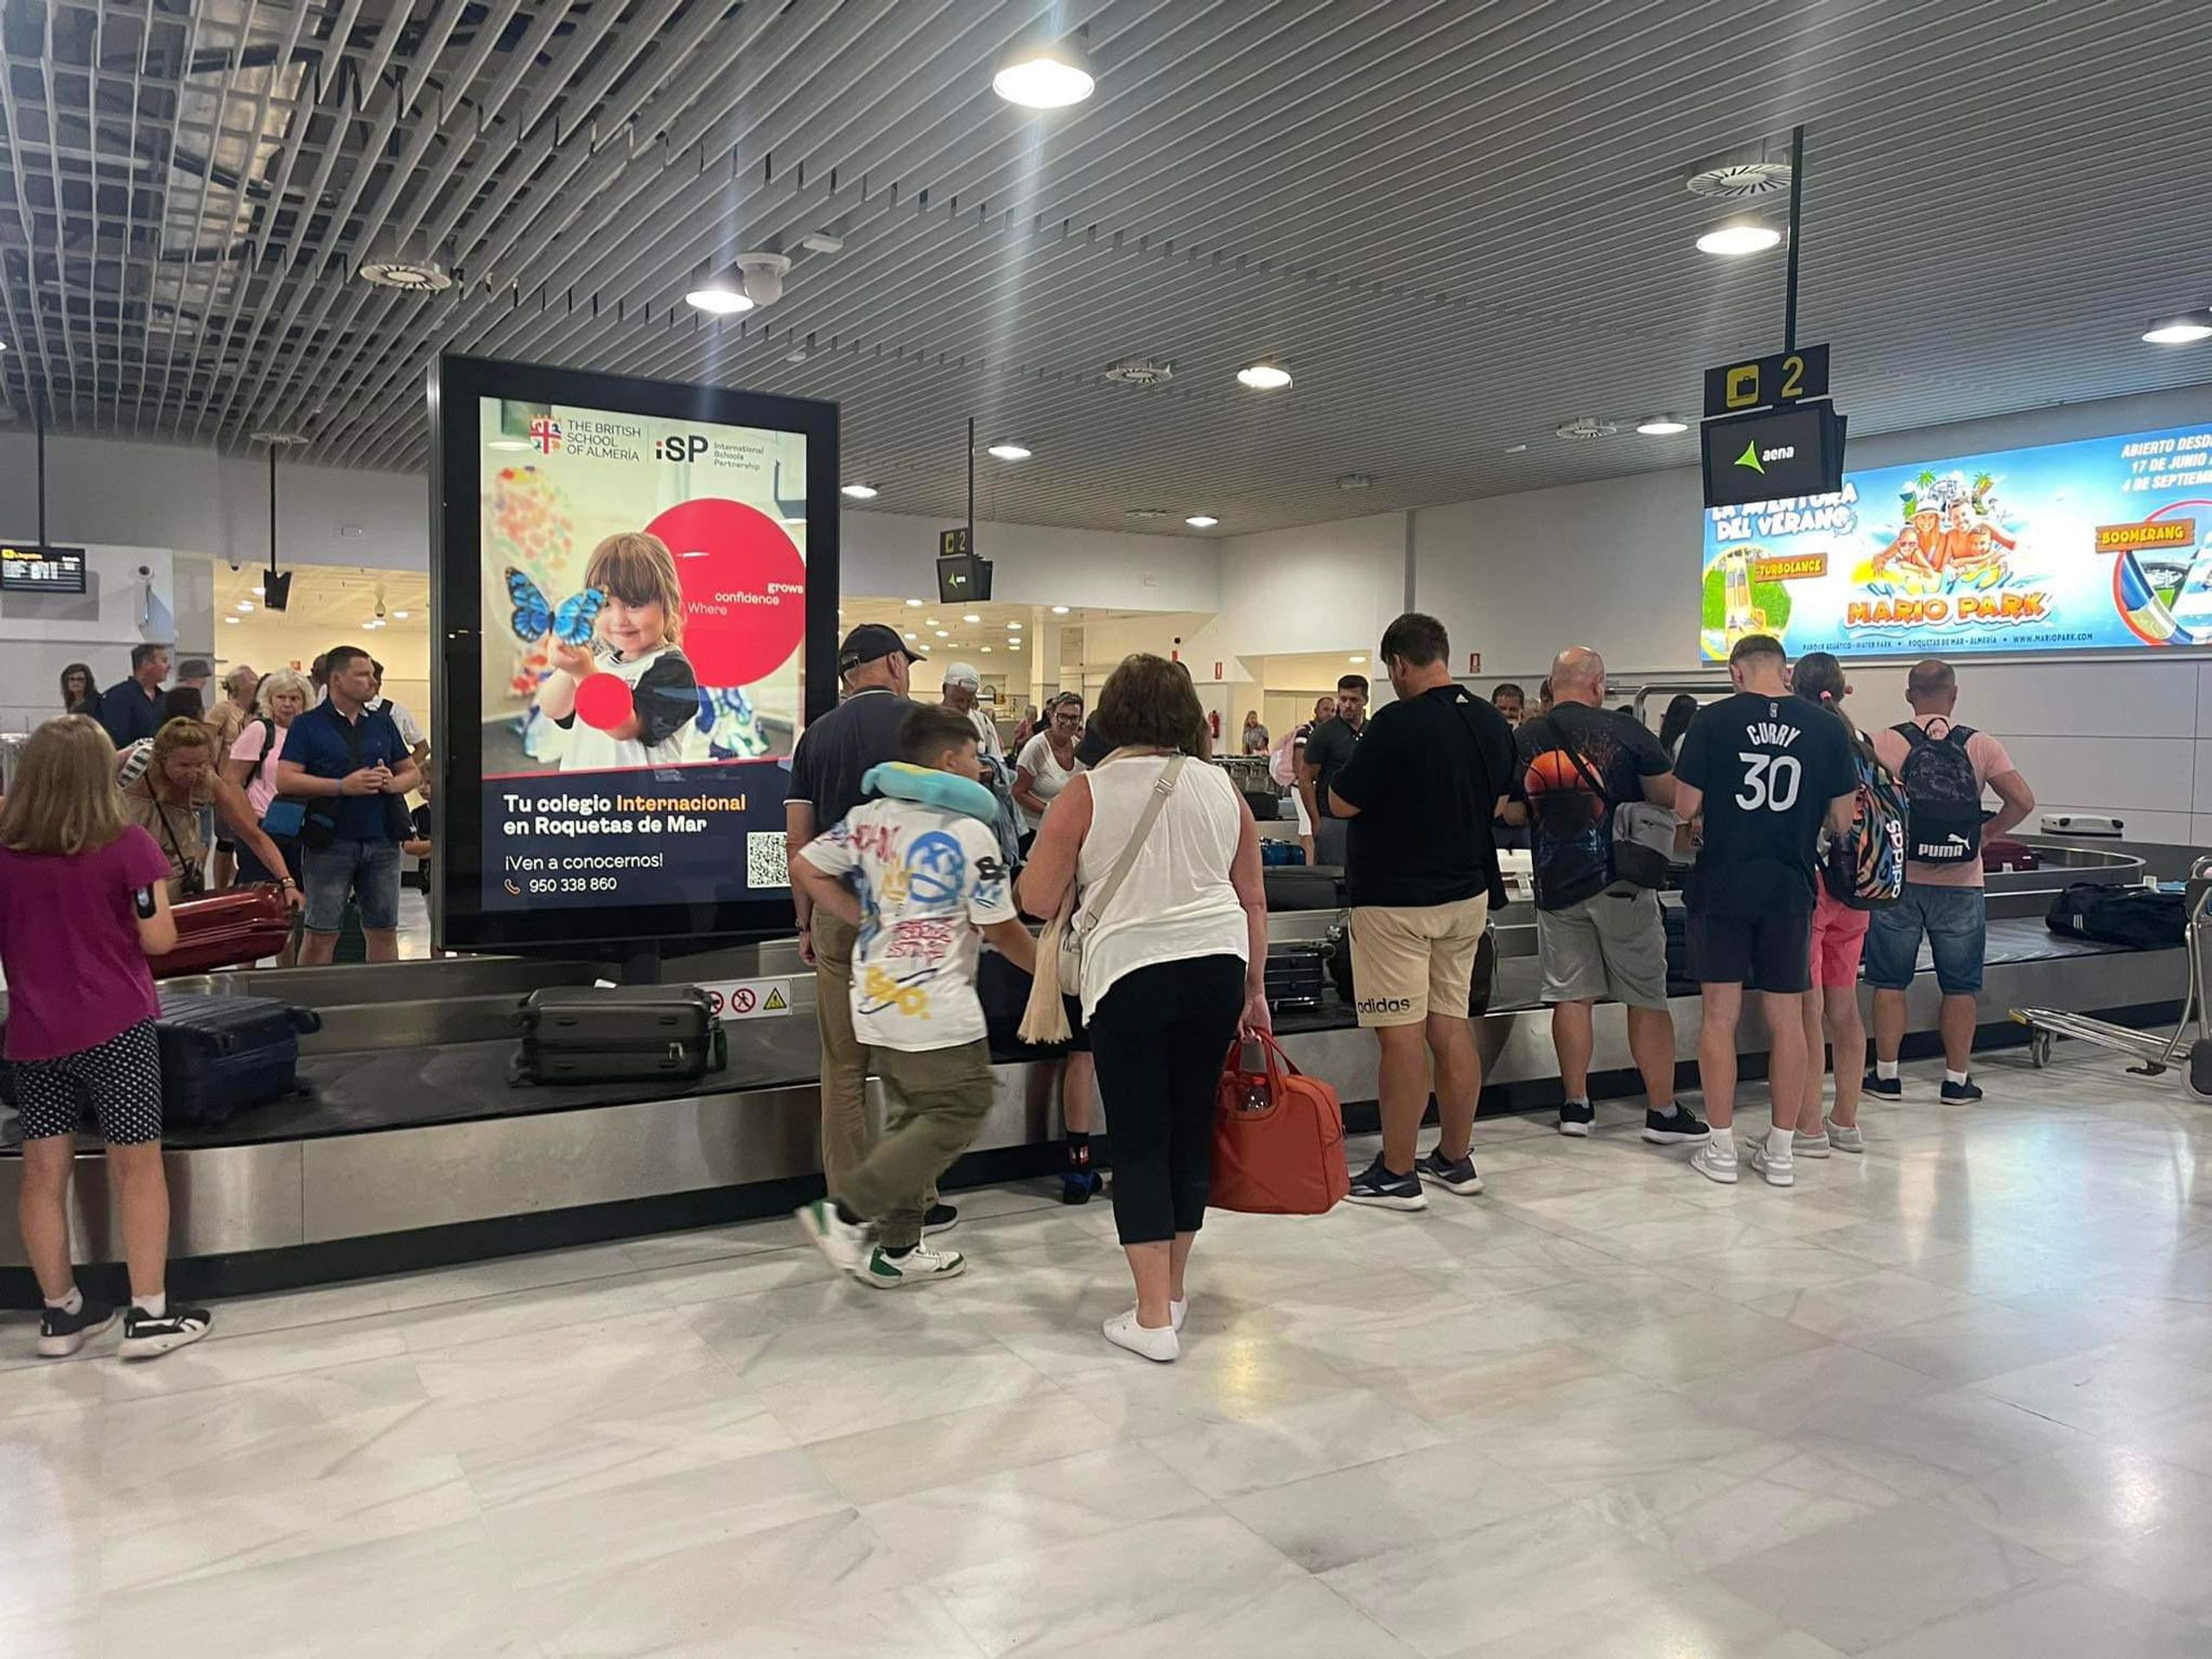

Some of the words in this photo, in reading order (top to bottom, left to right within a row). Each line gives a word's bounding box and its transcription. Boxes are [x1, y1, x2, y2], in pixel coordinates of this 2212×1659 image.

[1781, 356, 1804, 398] 2
[568, 420, 591, 432] THE
[595, 423, 641, 438] BRITISH
[567, 434, 618, 448] SCHOOL
[656, 435, 709, 463] iSP
[714, 442, 764, 454] International
[2120, 440, 2175, 458] ABIERTO
[2177, 435, 2212, 450] DESD
[567, 445, 583, 456] OF
[586, 446, 640, 462] ALMERÍA
[714, 450, 744, 461] Schools
[1763, 446, 1795, 462] aena
[714, 459, 761, 471] Partnership
[2132, 459, 2148, 474] 17
[2149, 458, 2167, 472] DE
[2168, 453, 2206, 469] JUNIO
[2121, 479, 2133, 493] 4
[2133, 476, 2151, 491] DE
[1718, 517, 1752, 541] DEL
[2101, 525, 2184, 545] BOOMERANG
[959, 531, 966, 551] 2
[1759, 559, 1822, 577] TURBOLANCE
[766, 582, 804, 594] grows
[715, 591, 779, 606] confidence
[687, 602, 728, 615] Where
[1847, 597, 1948, 625] MARIO
[1957, 592, 2046, 619] PARK
[2013, 633, 2094, 644] WWW.MARIOPARK.COM
[1746, 722, 1802, 748] CURRY
[1735, 752, 1802, 811] 30
[503, 794, 531, 813] Tu
[537, 794, 612, 816] colegio
[616, 793, 747, 812] Internacional
[503, 819, 530, 836] en
[535, 817, 633, 838] Roquetas
[638, 815, 663, 833] de
[668, 815, 708, 833] Mar
[1885, 819, 1904, 899] adidas
[1918, 843, 1963, 857] PUMA
[505, 855, 544, 873] ¡Ven
[548, 859, 558, 871] a
[563, 852, 664, 871] conocernos!
[529, 879, 557, 893] 950
[560, 878, 588, 893] 338
[590, 876, 618, 892] 860
[1357, 998, 1410, 1014] adidas
